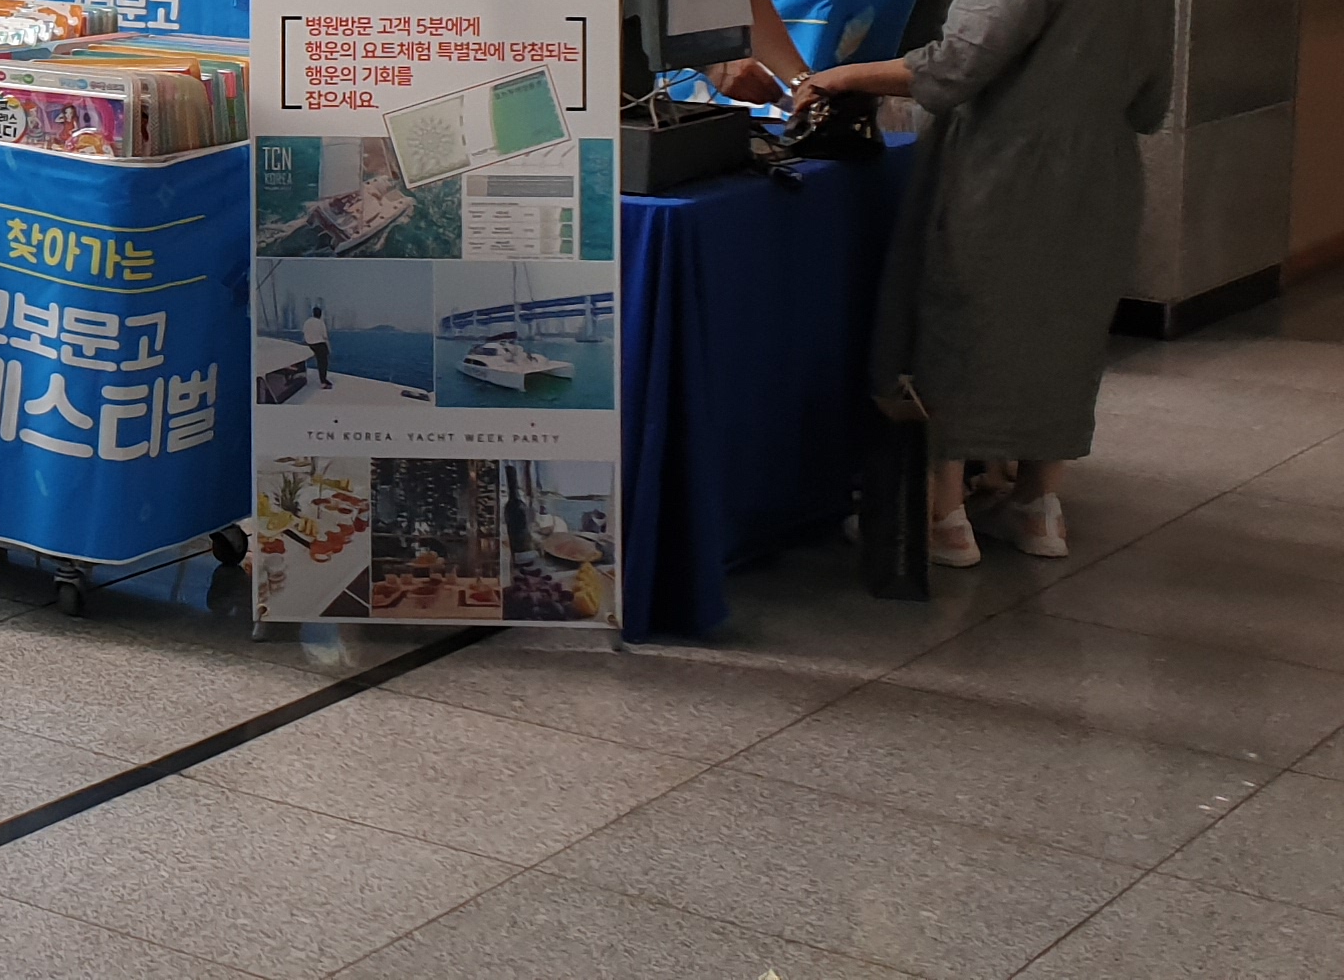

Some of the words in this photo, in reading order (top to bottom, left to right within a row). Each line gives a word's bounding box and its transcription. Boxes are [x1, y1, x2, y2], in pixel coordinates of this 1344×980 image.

[305, 16, 374, 37] 병원방문
[377, 17, 412, 37] 고객
[416, 17, 480, 37] 5분에게
[304, 41, 358, 62] 행운의
[361, 42, 432, 62] 요트체험
[435, 42, 506, 62] 특별권에
[509, 42, 581, 62] 당첨되는
[304, 66, 358, 87] 행운의
[362, 66, 414, 87] 기회를
[305, 91, 380, 111] 잡으세요.
[262, 146, 292, 171] TCN
[6, 217, 157, 282] 찾아가는
[307, 430, 335, 442] TCN
[343, 431, 393, 442] KOREA
[407, 432, 454, 443] YACHT
[465, 432, 505, 443] WEEK
[513, 433, 561, 444] PARTY
